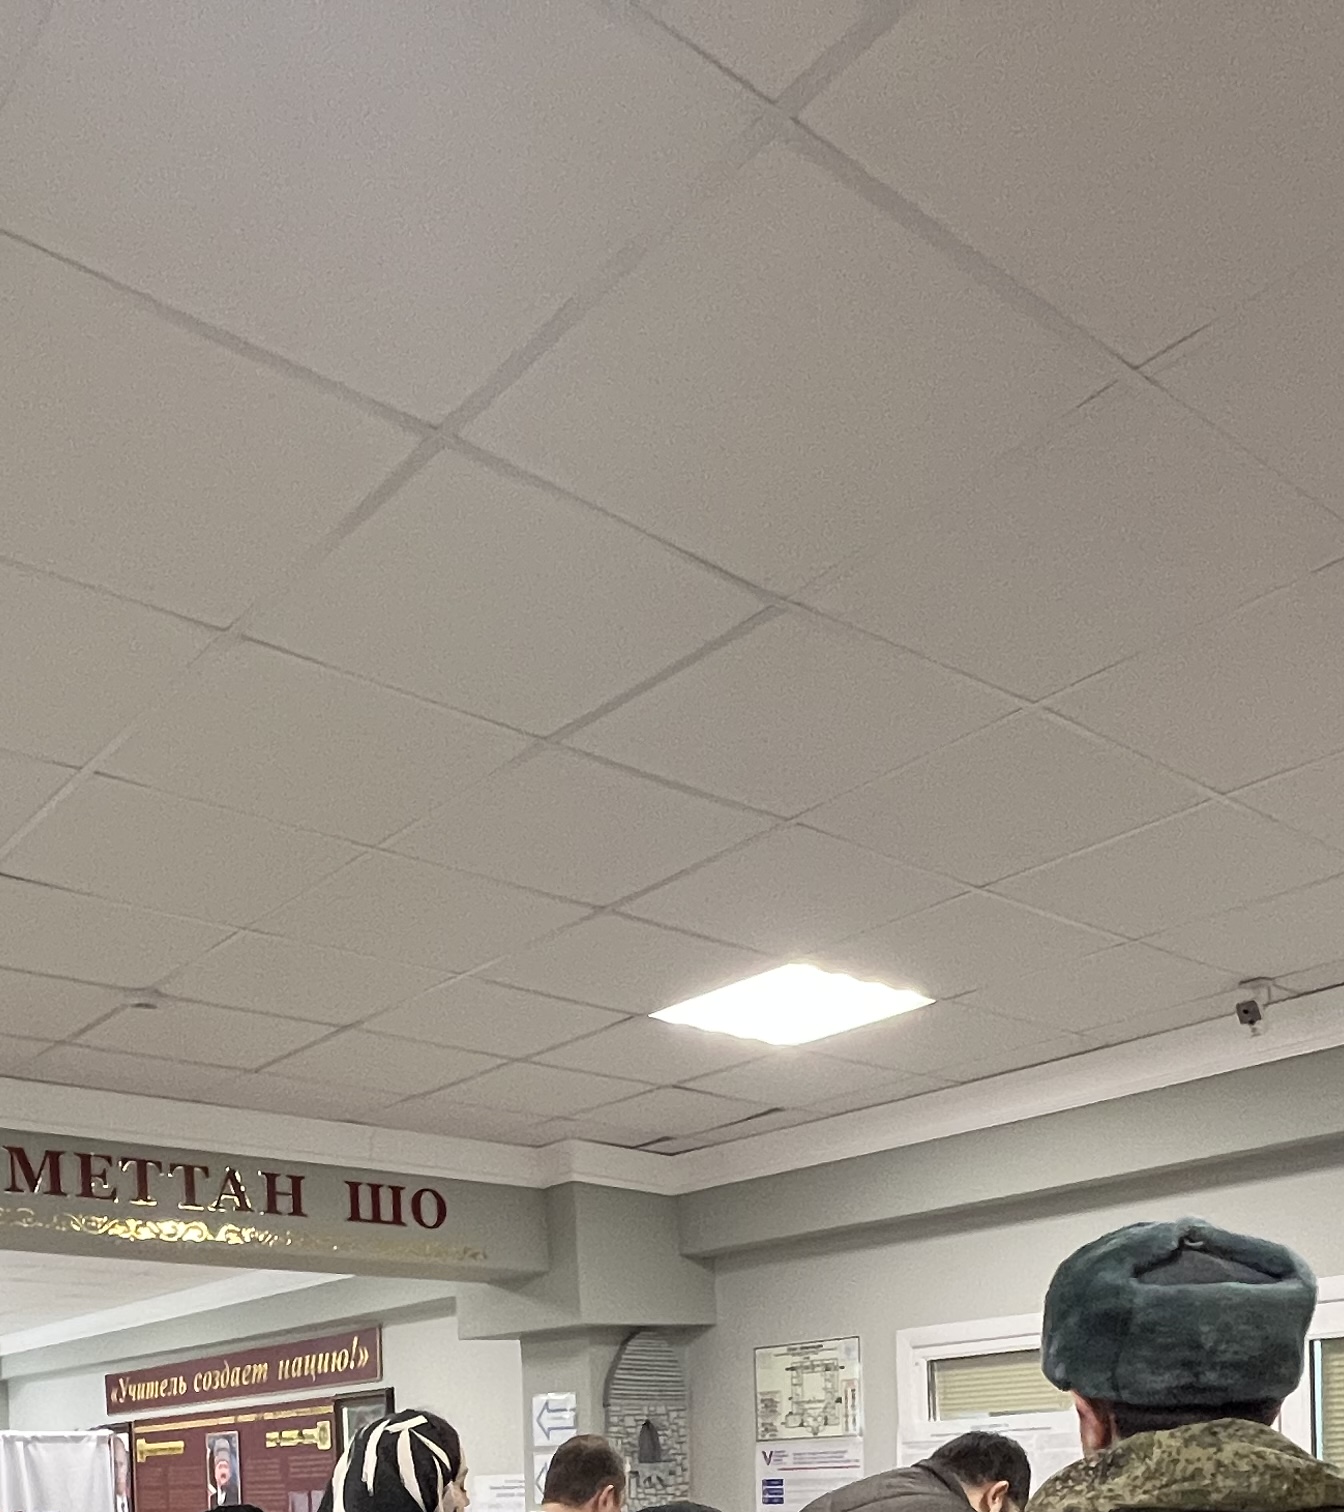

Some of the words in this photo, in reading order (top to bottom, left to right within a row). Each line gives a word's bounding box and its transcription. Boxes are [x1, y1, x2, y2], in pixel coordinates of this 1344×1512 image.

[2, 1144, 309, 1218] МЕТТАН
[343, 1180, 448, 1230] ШО
[110, 1375, 188, 1404] «Учитель
[193, 1359, 269, 1394] создает
[278, 1335, 370, 1383] нацию!»
